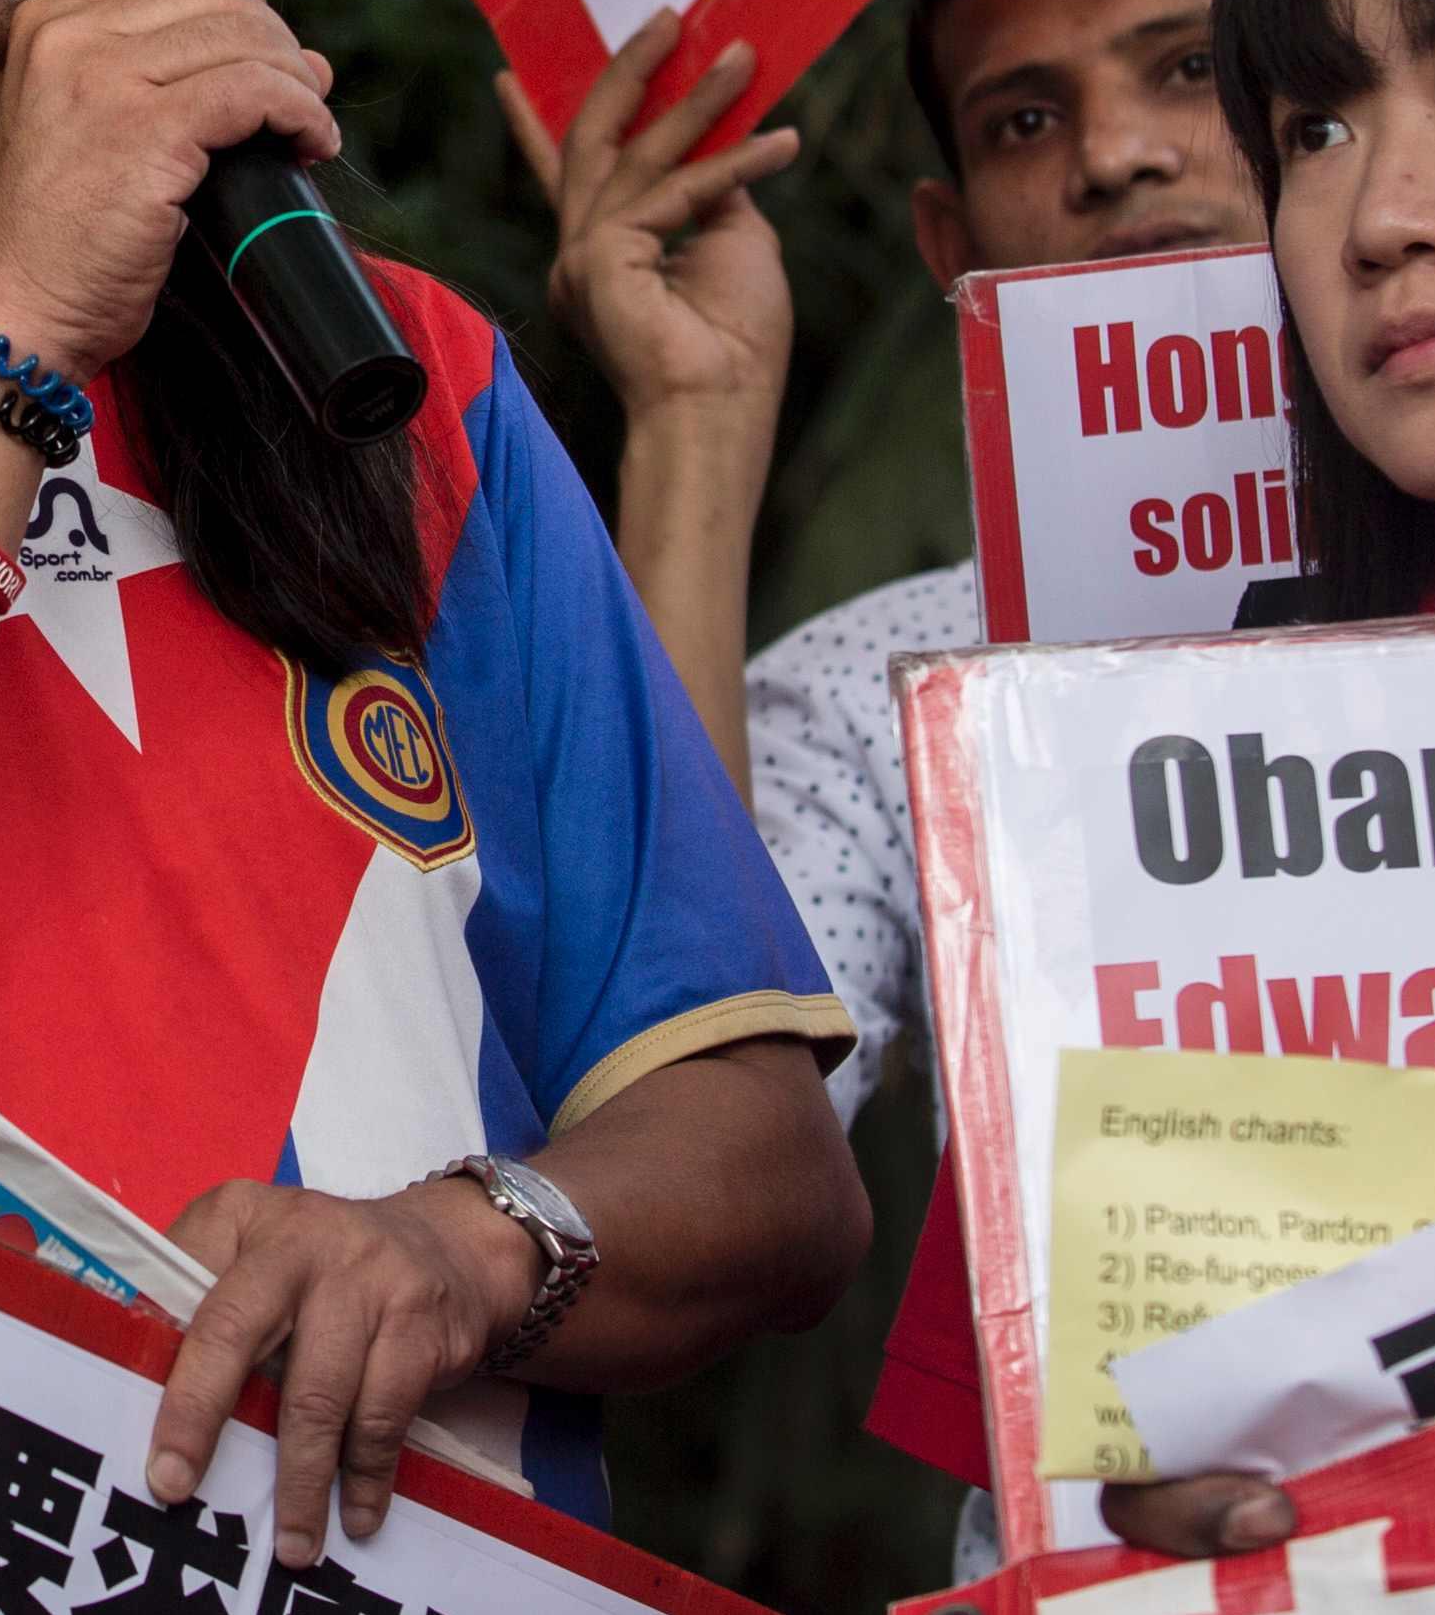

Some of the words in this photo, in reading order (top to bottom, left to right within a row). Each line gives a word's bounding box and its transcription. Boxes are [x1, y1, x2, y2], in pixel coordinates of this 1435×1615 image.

[19, 546, 82, 570] Sport
[1101, 1104, 1222, 1146] English
[1229, 1115, 1348, 1148] chants:
[1103, 1204, 1136, 1241] 1)
[1143, 1203, 1271, 1242] Pardon,
[1098, 1251, 1136, 1290] 2)
[1097, 1298, 1135, 1340] 3)
[1142, 1298, 1213, 1334] Ref
